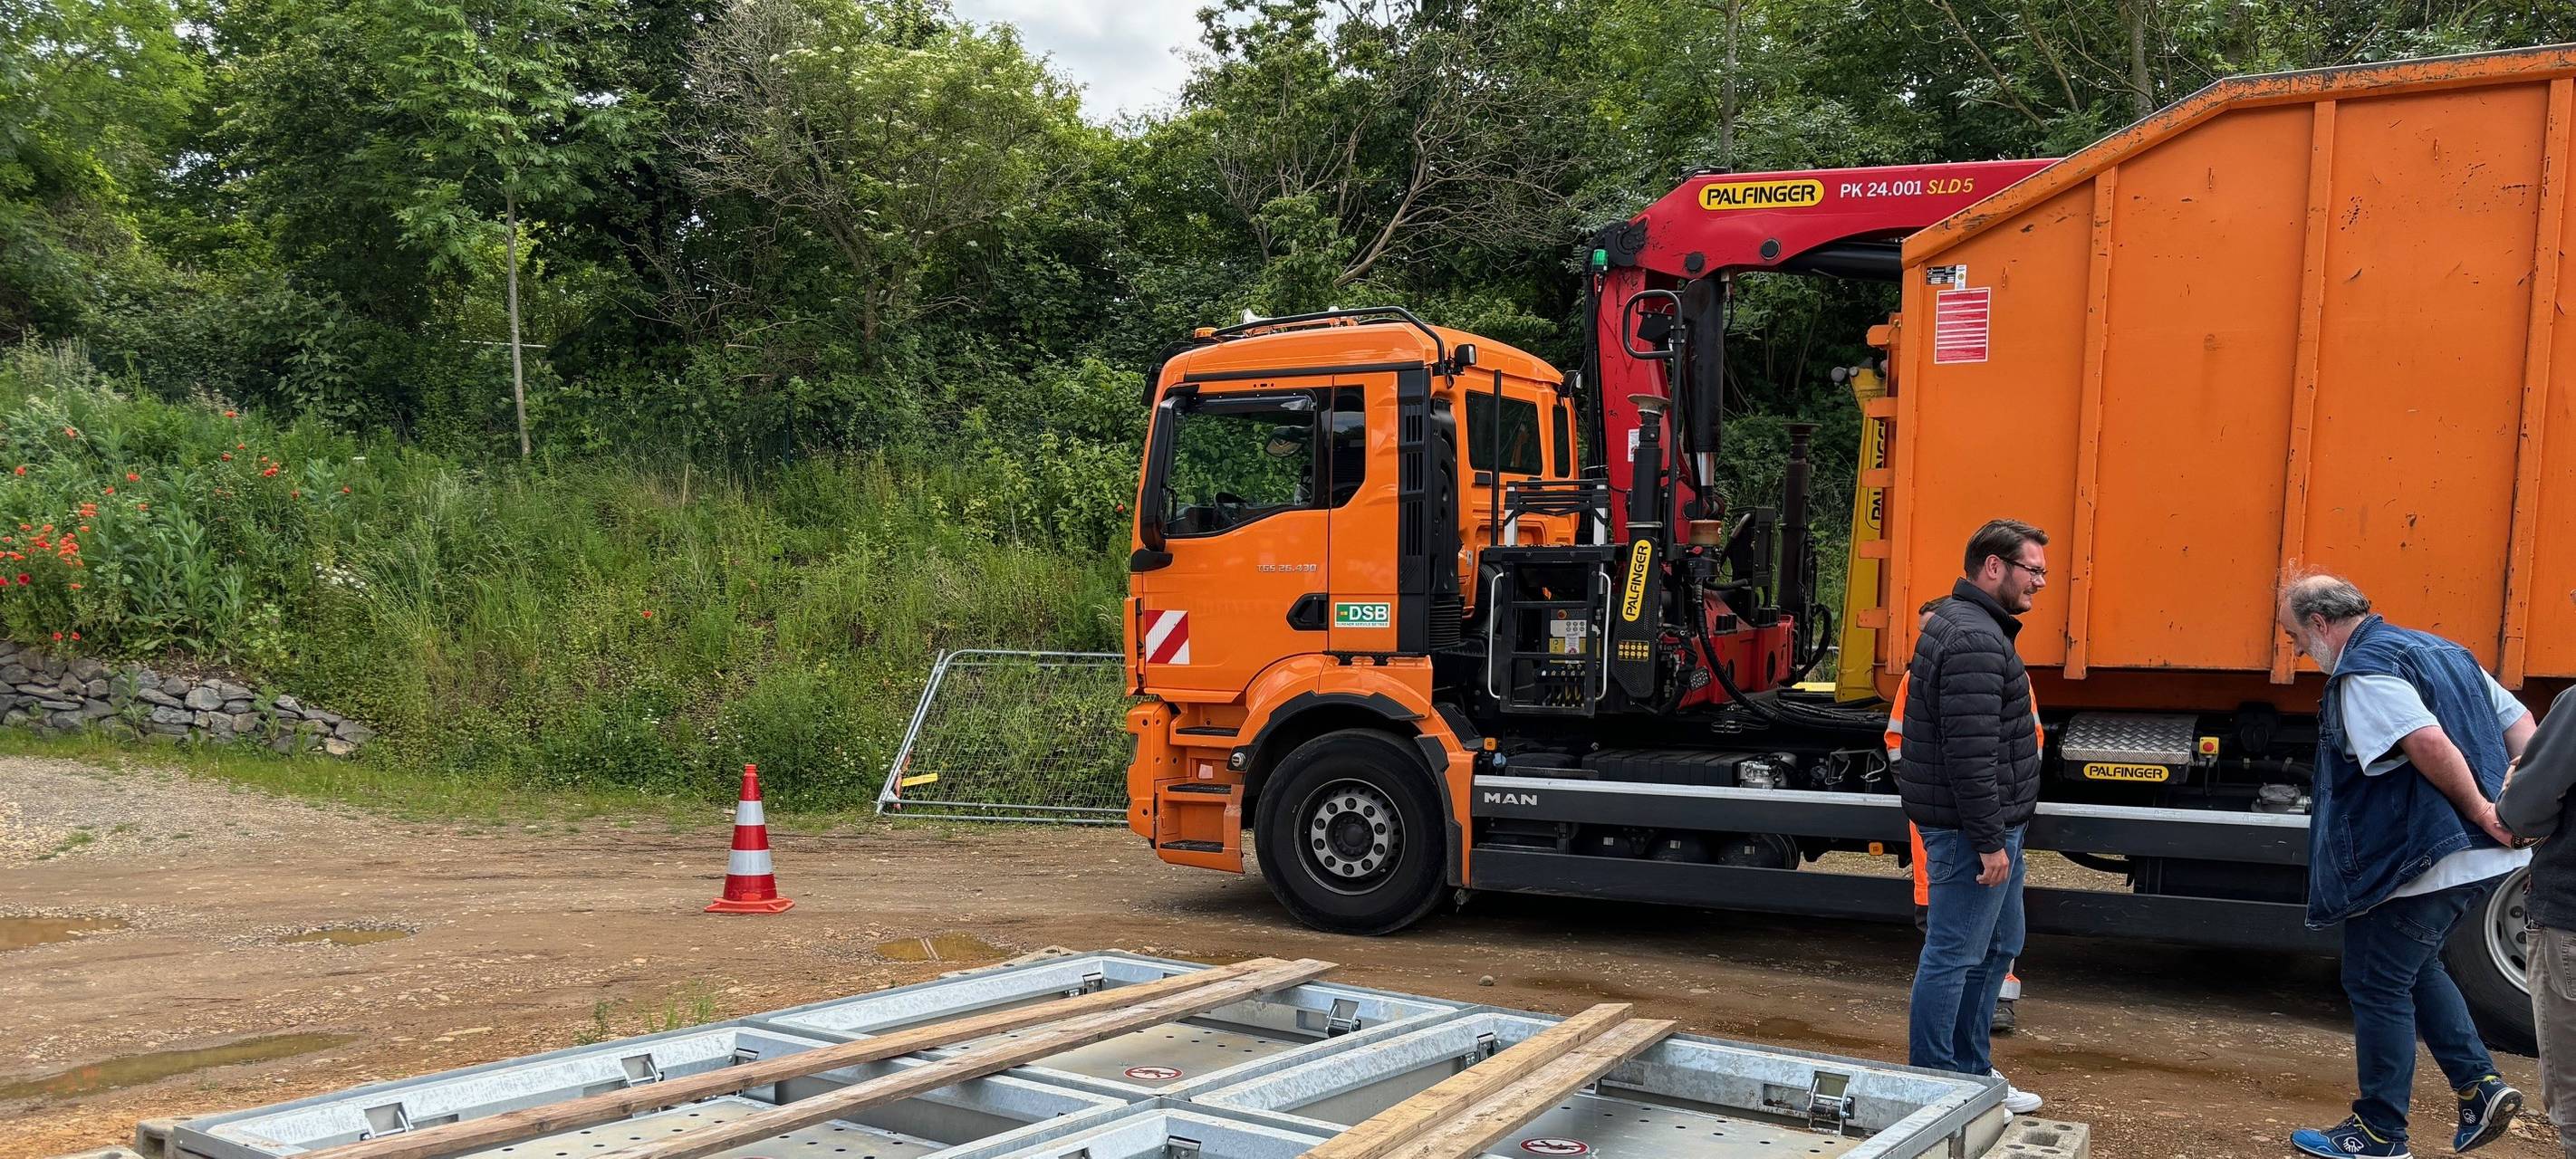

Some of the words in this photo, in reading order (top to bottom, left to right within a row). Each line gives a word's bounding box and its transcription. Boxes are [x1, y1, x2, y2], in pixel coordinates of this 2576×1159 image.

[1706, 184, 1816, 206] PALFINGER
[1840, 183, 1863, 198] PK
[1867, 180, 1922, 197] 24.001
[1256, 564, 1276, 573] TGS
[1626, 545, 1648, 617] PALFINGER
[1349, 606, 1387, 620] DSB
[2089, 766, 2163, 779] PALFINGER
[1485, 792, 1538, 805] MAN
